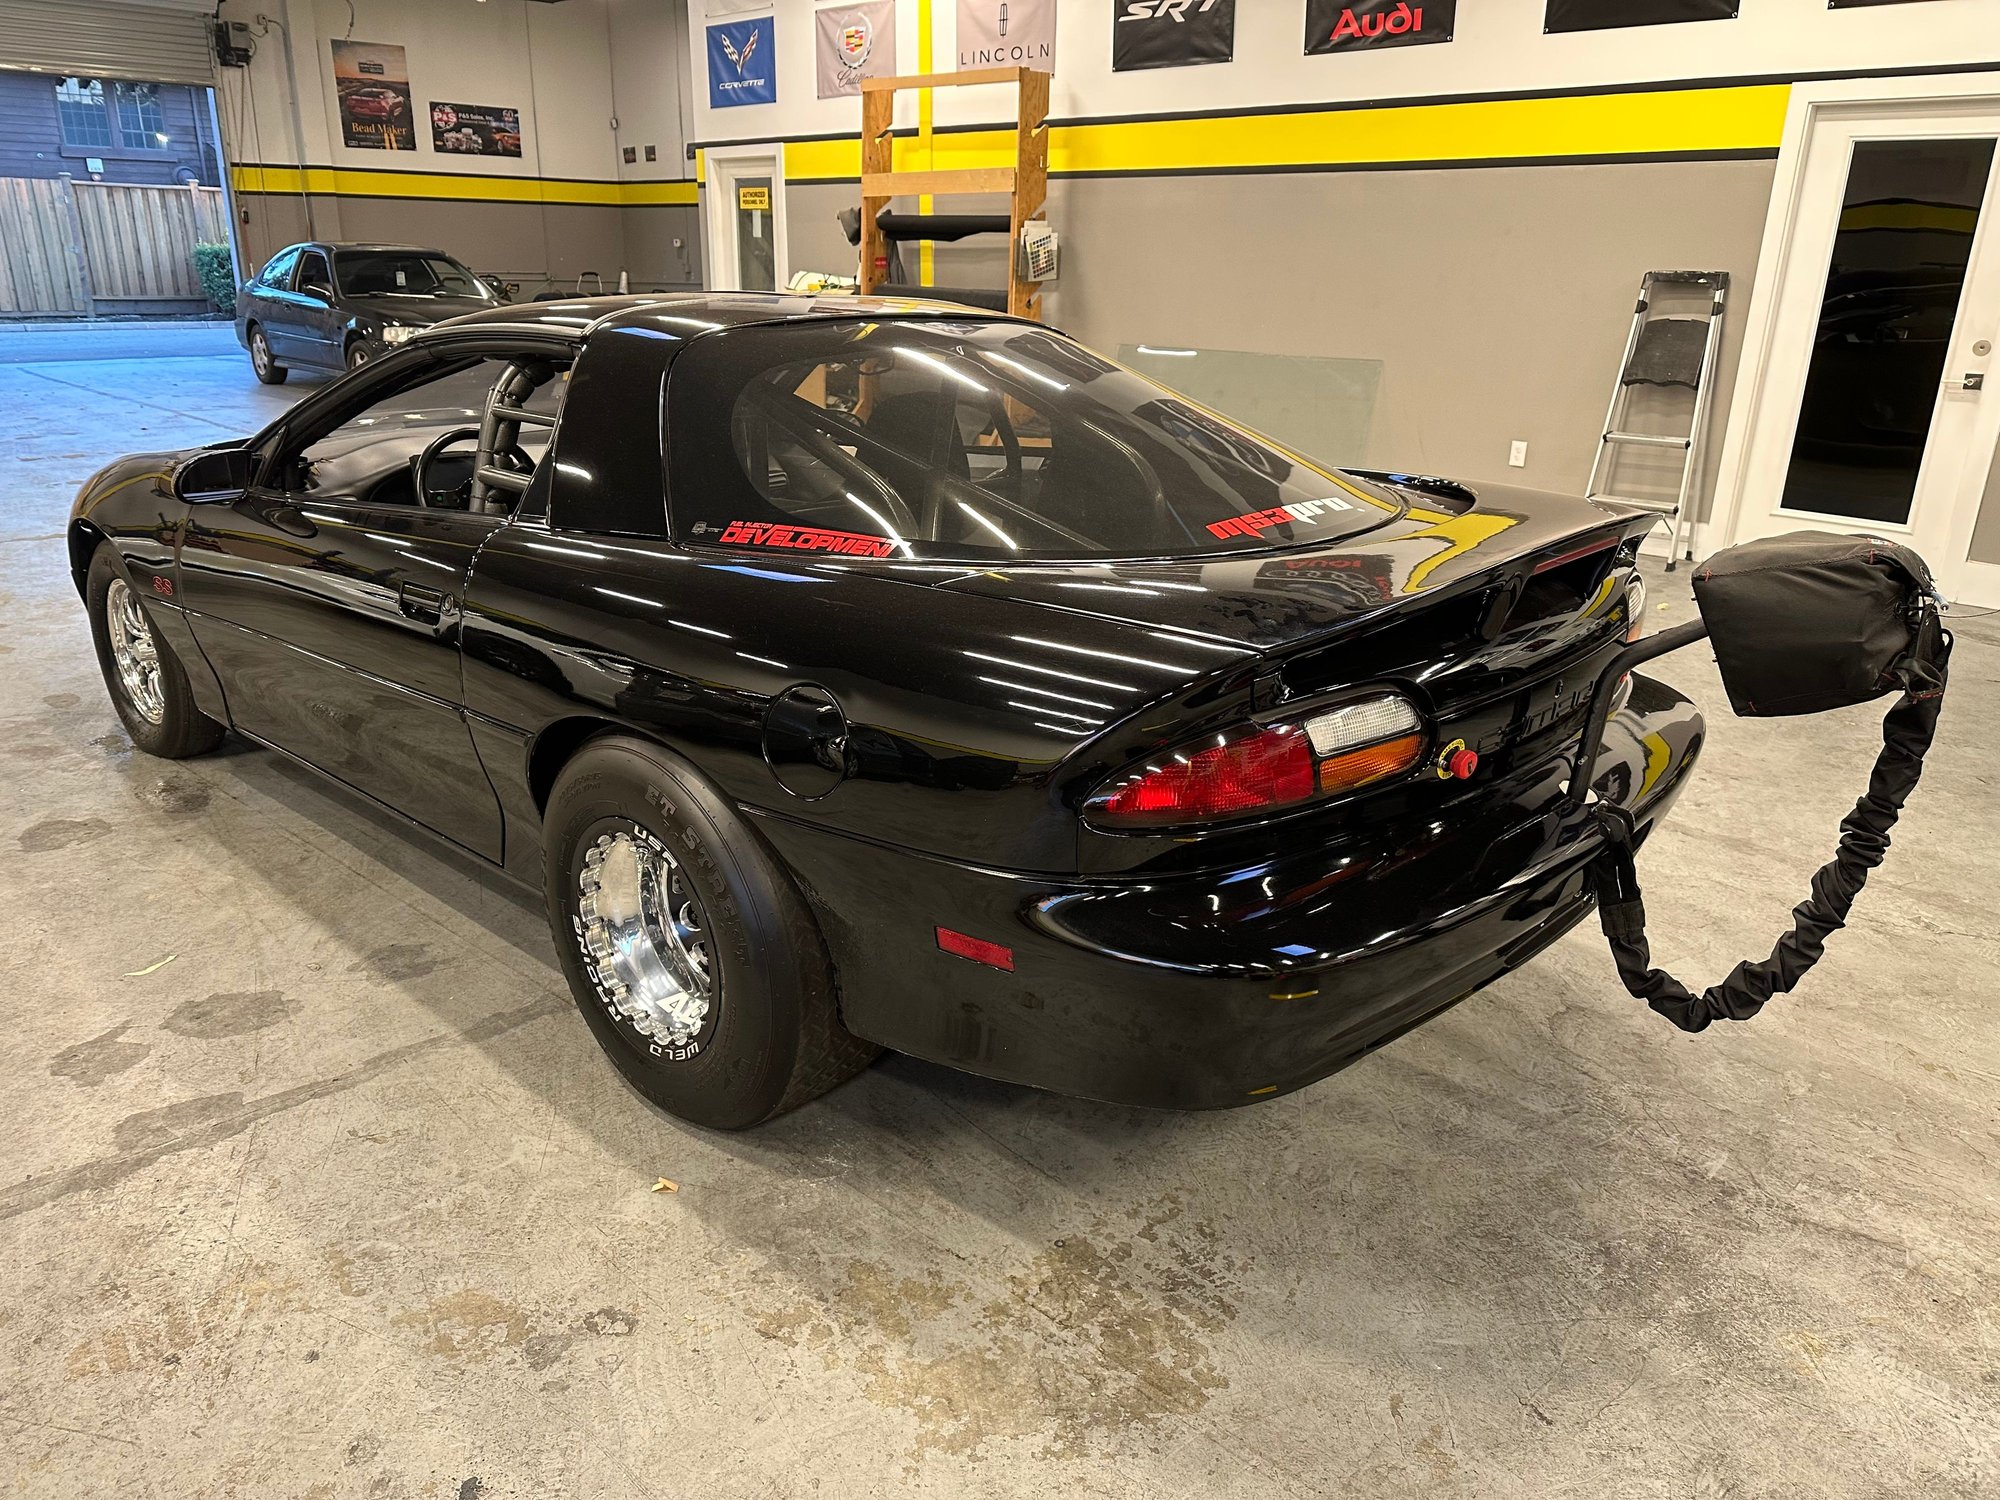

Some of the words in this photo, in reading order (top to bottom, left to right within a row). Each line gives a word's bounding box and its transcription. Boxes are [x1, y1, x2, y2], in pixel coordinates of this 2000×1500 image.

[1330, 2, 1423, 40] Audi
[961, 43, 1050, 65] LINCOLN
[719, 78, 765, 90] CORVETTE
[433, 111, 457, 122] P&S
[352, 122, 375, 133] Bead
[377, 123, 407, 135] Maker
[744, 521, 773, 529] INJECTOR
[719, 524, 911, 558] DEVELOPMENT
[153, 576, 173, 596] SS
[633, 824, 678, 870] USA
[573, 914, 622, 1022] RACING
[650, 1042, 700, 1061] WELD
